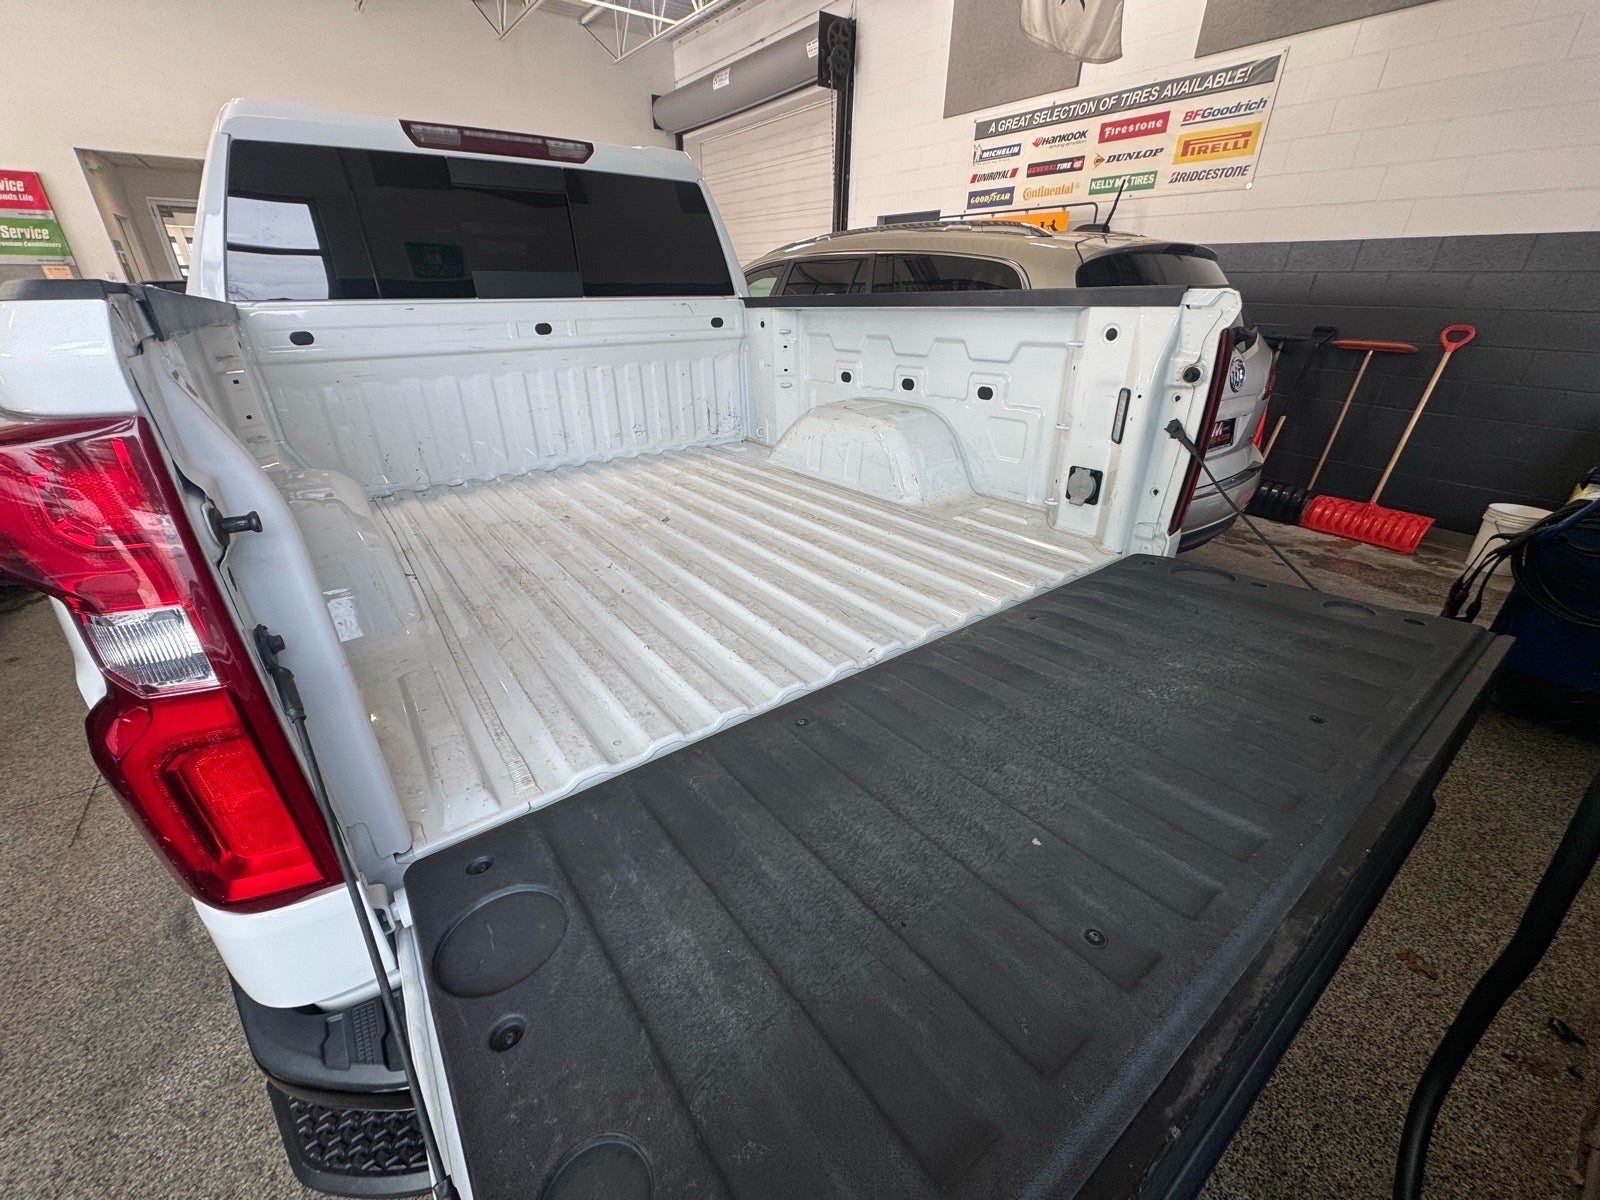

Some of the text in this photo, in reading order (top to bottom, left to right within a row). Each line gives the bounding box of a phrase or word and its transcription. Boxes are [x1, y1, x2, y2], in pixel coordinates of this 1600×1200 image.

[989, 66, 1253, 134] A GREAT SELECTION OF TIRES AVAILABLE!
[1183, 98, 1267, 122] BFGoodrich
[1104, 119, 1163, 138] Firestone
[982, 145, 1020, 158] MICHELIN
[1180, 130, 1253, 158] PIRELLI
[1105, 147, 1164, 163] DUNLOP
[976, 169, 1010, 183] UNIROYAL
[1027, 165, 1057, 175] GENERAL
[1056, 162, 1073, 171] TIRE
[1168, 165, 1250, 184] BRIDGESTONE
[1091, 178, 1115, 190] KELLY
[1130, 174, 1155, 186] TIRES
[18, 194, 34, 202] Life
[970, 192, 1011, 204] GOODYEAR
[1023, 183, 1074, 200] Continental
[1, 225, 49, 239] Service
